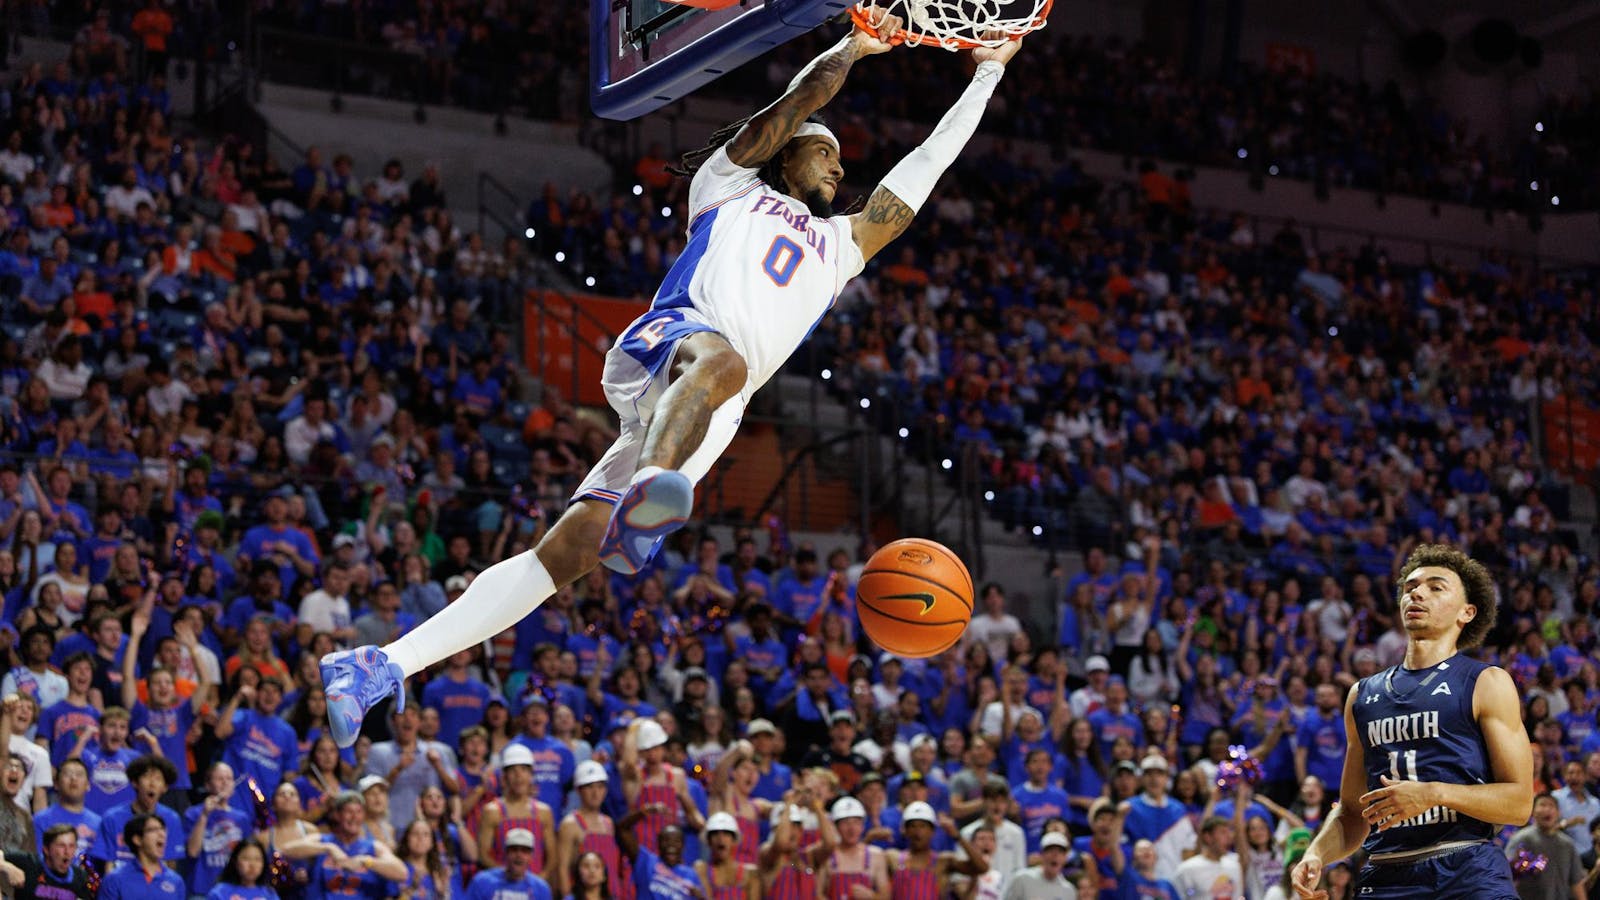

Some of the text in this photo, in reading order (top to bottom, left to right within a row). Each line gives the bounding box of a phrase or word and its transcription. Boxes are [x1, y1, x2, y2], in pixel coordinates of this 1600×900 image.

[750, 195, 826, 265] FLORDA
[761, 234, 805, 287] 0
[633, 316, 675, 351] F
[1368, 711, 1440, 748] NORTH
[1388, 749, 1418, 782] 11
